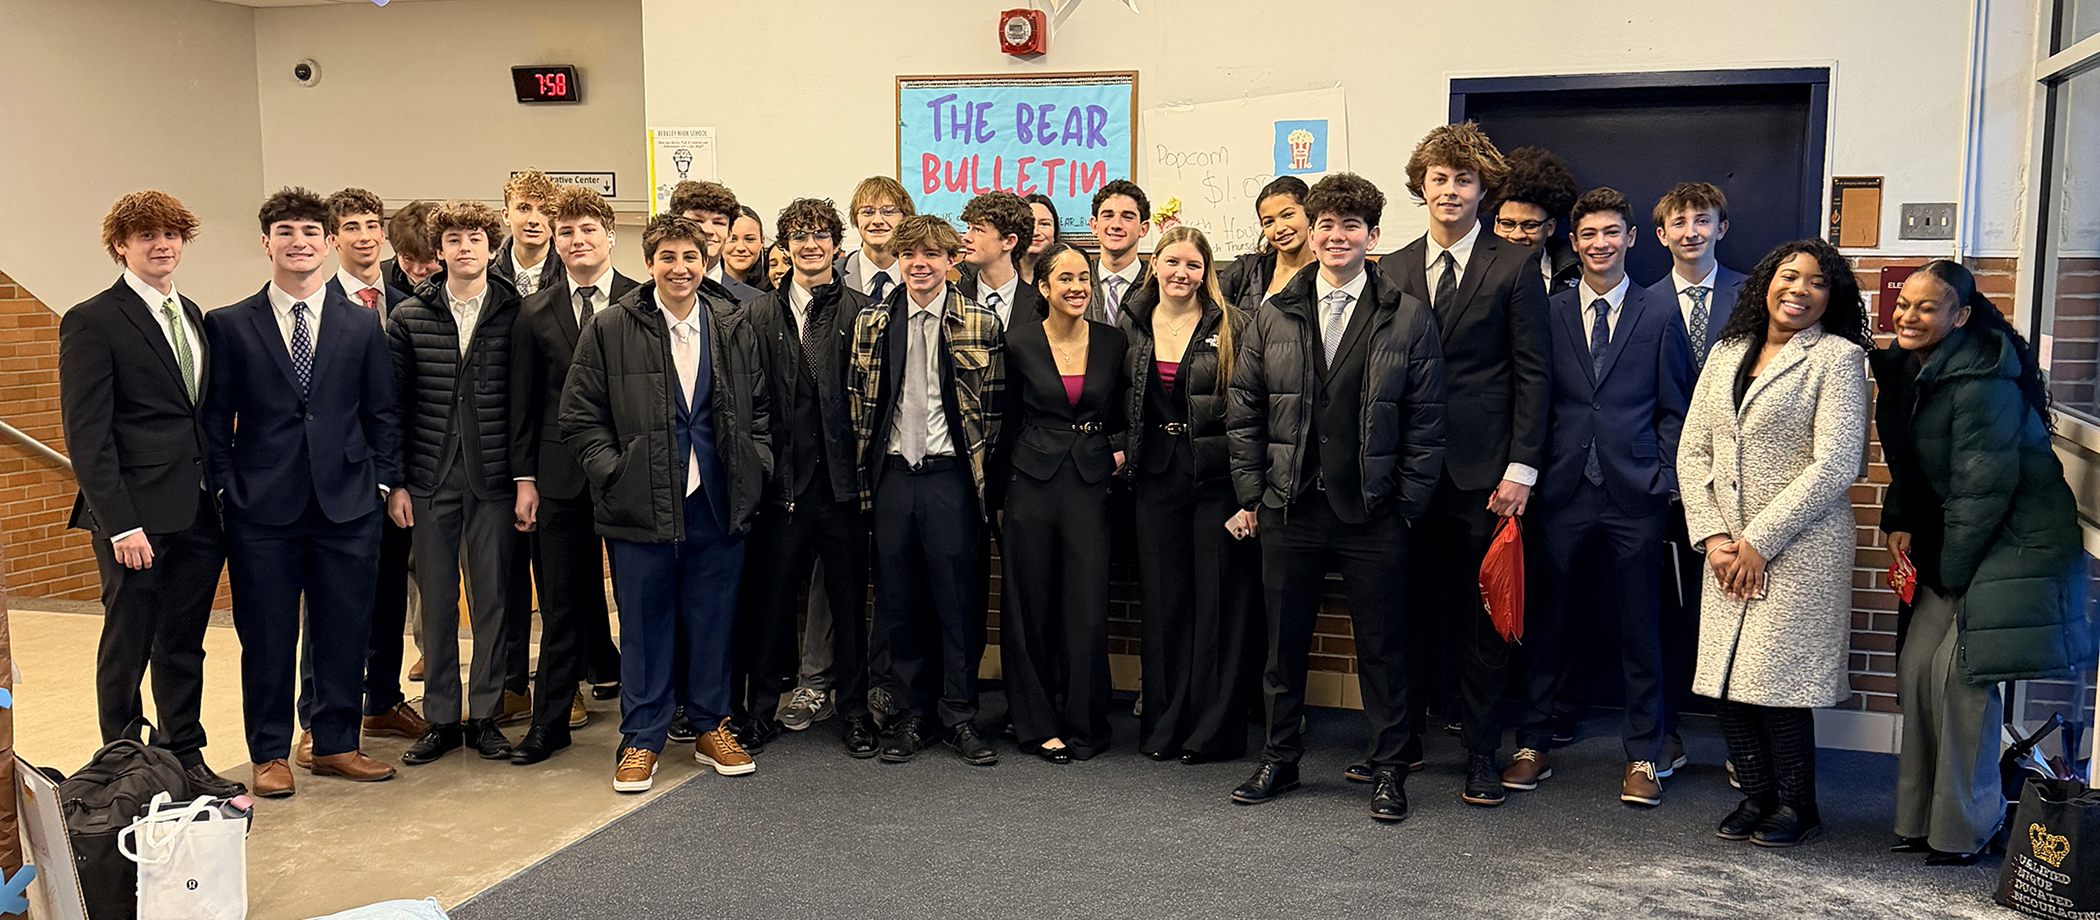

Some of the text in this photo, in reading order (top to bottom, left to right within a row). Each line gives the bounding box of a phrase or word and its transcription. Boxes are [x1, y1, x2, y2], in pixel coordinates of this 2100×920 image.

[534, 73, 567, 97] 7:58
[926, 93, 1109, 149] THE BEAR
[575, 176, 599, 184] Center
[921, 153, 1107, 198] BULLETIN
[1156, 144, 1229, 180] Popcorn
[1202, 170, 1274, 208] $1.0
[2009, 877, 2074, 908] DUCATED
